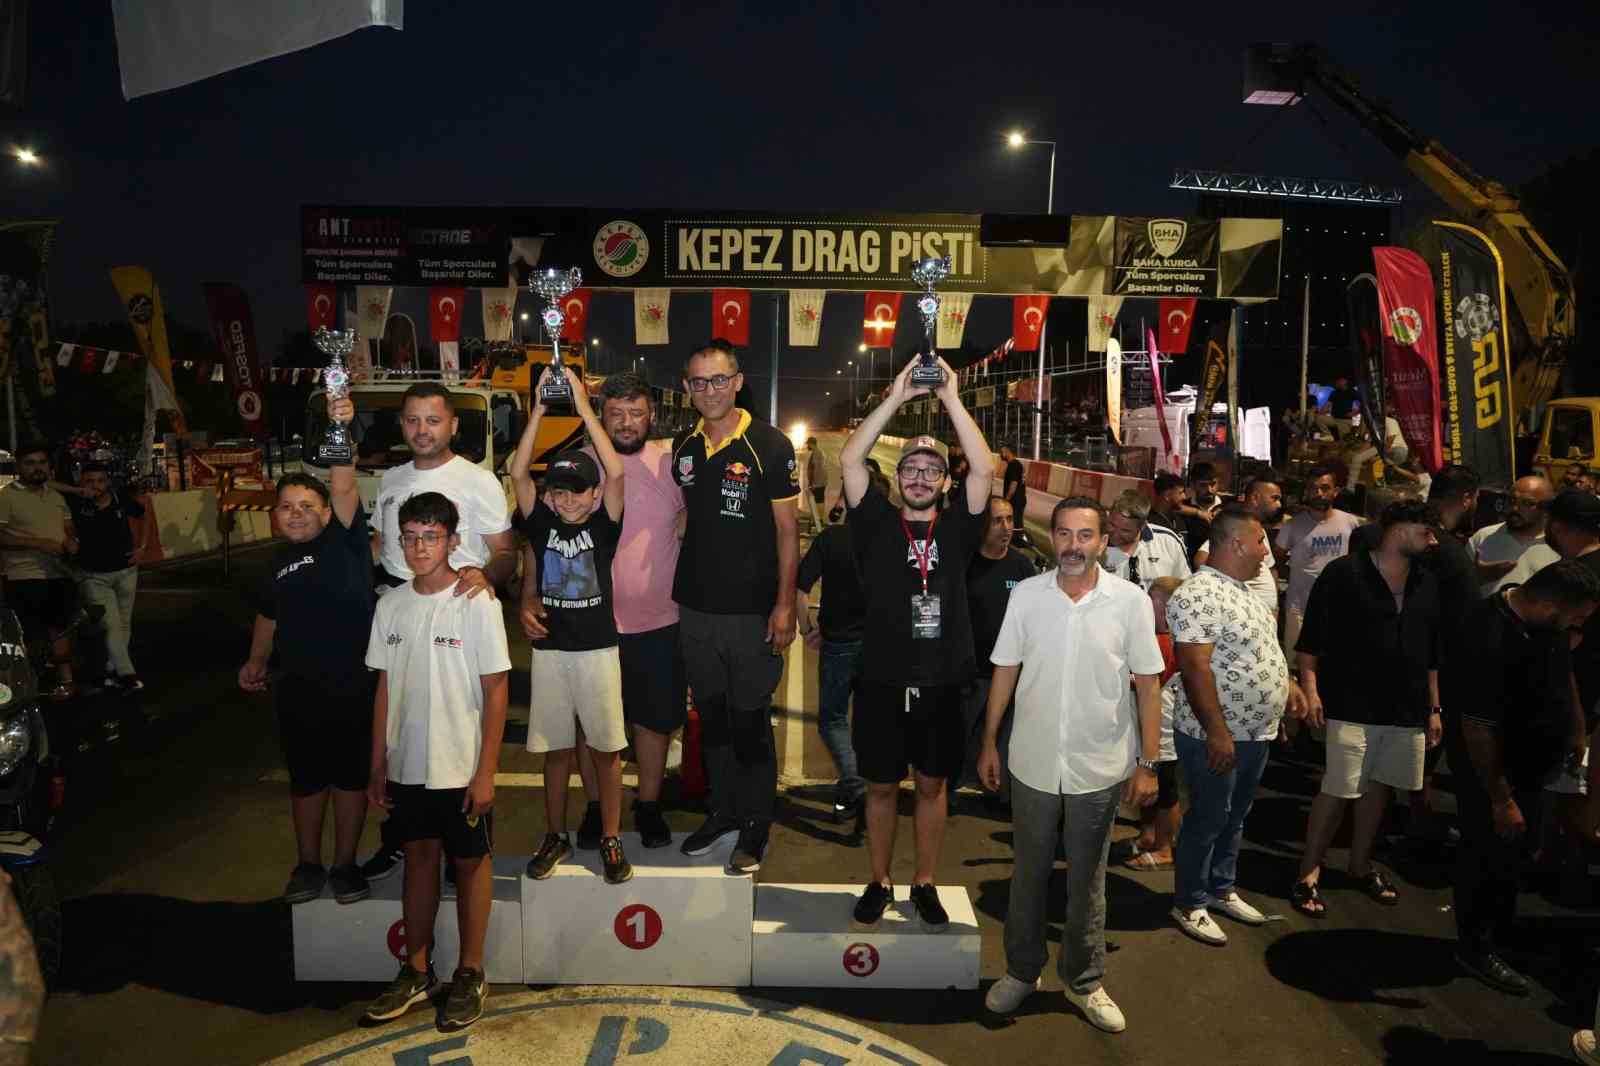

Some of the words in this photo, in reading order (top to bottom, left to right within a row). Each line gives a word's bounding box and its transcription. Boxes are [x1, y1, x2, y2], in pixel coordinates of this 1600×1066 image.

[677, 228, 784, 271] KEPEZ
[791, 229, 882, 273] DRAG
[1126, 270, 1147, 281] Tüm
[1150, 271, 1206, 283] Sporculara
[0, 642, 26, 658] TA
[626, 911, 647, 942] 1
[849, 946, 873, 973] 3
